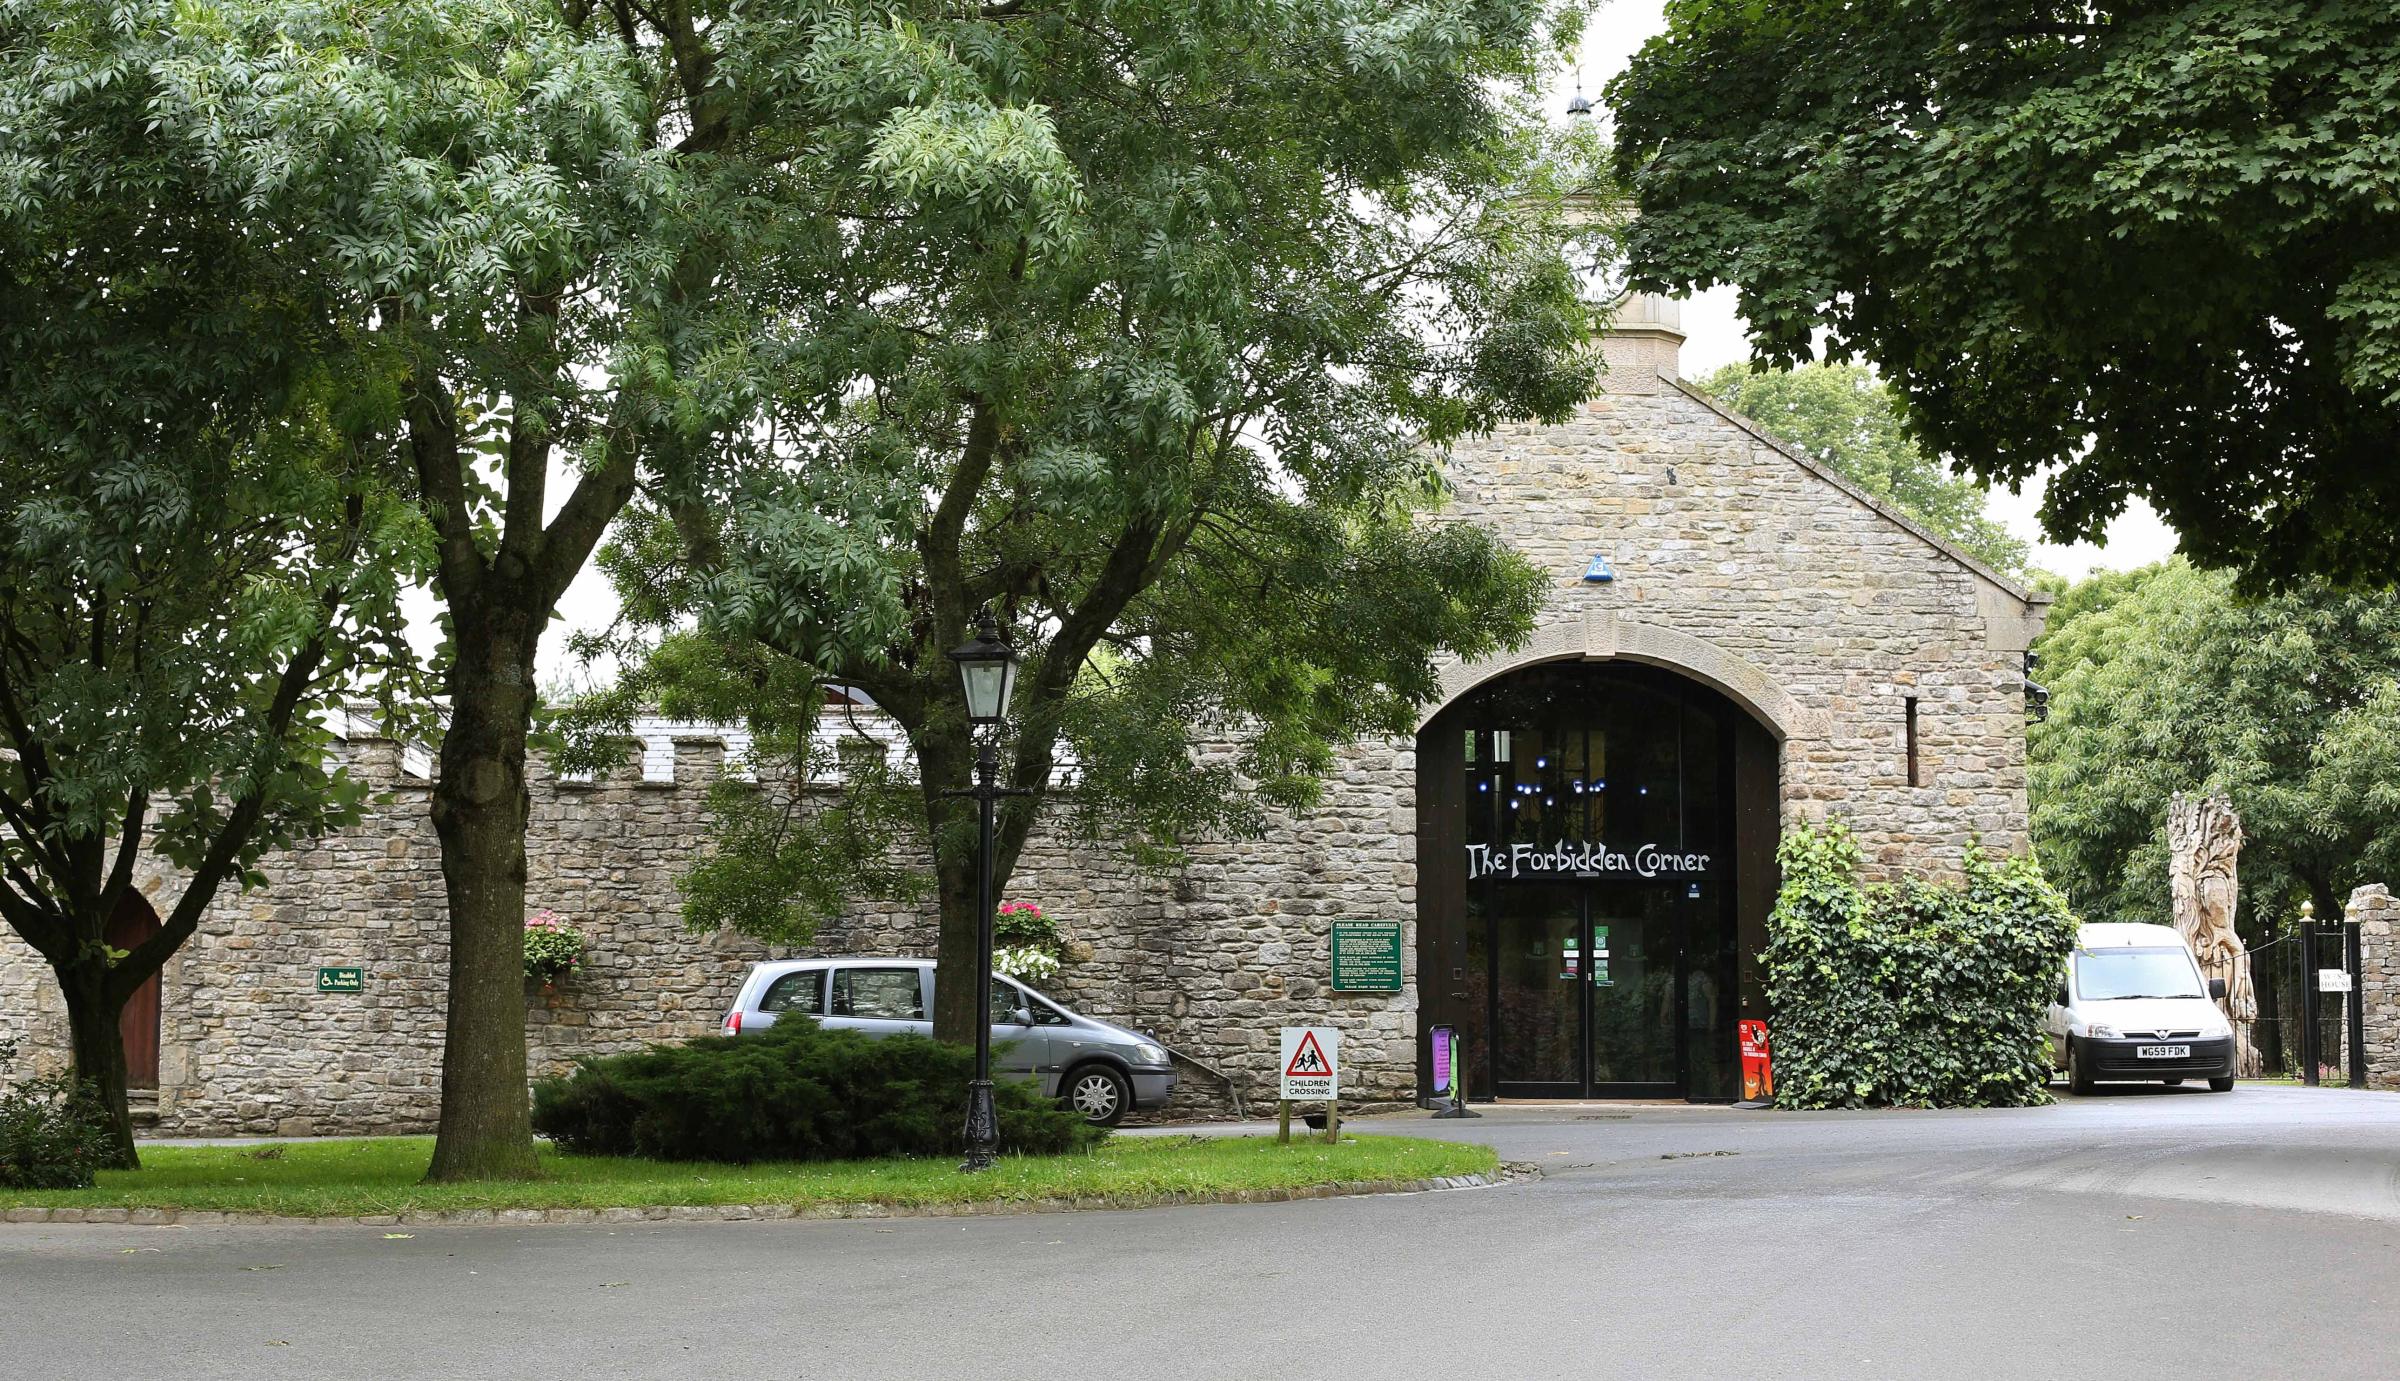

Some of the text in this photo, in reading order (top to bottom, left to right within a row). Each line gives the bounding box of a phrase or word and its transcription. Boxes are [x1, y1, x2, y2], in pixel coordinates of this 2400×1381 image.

[1465, 838, 1711, 879] The Forbidden Corner
[2168, 1046, 2186, 1056] FDK
